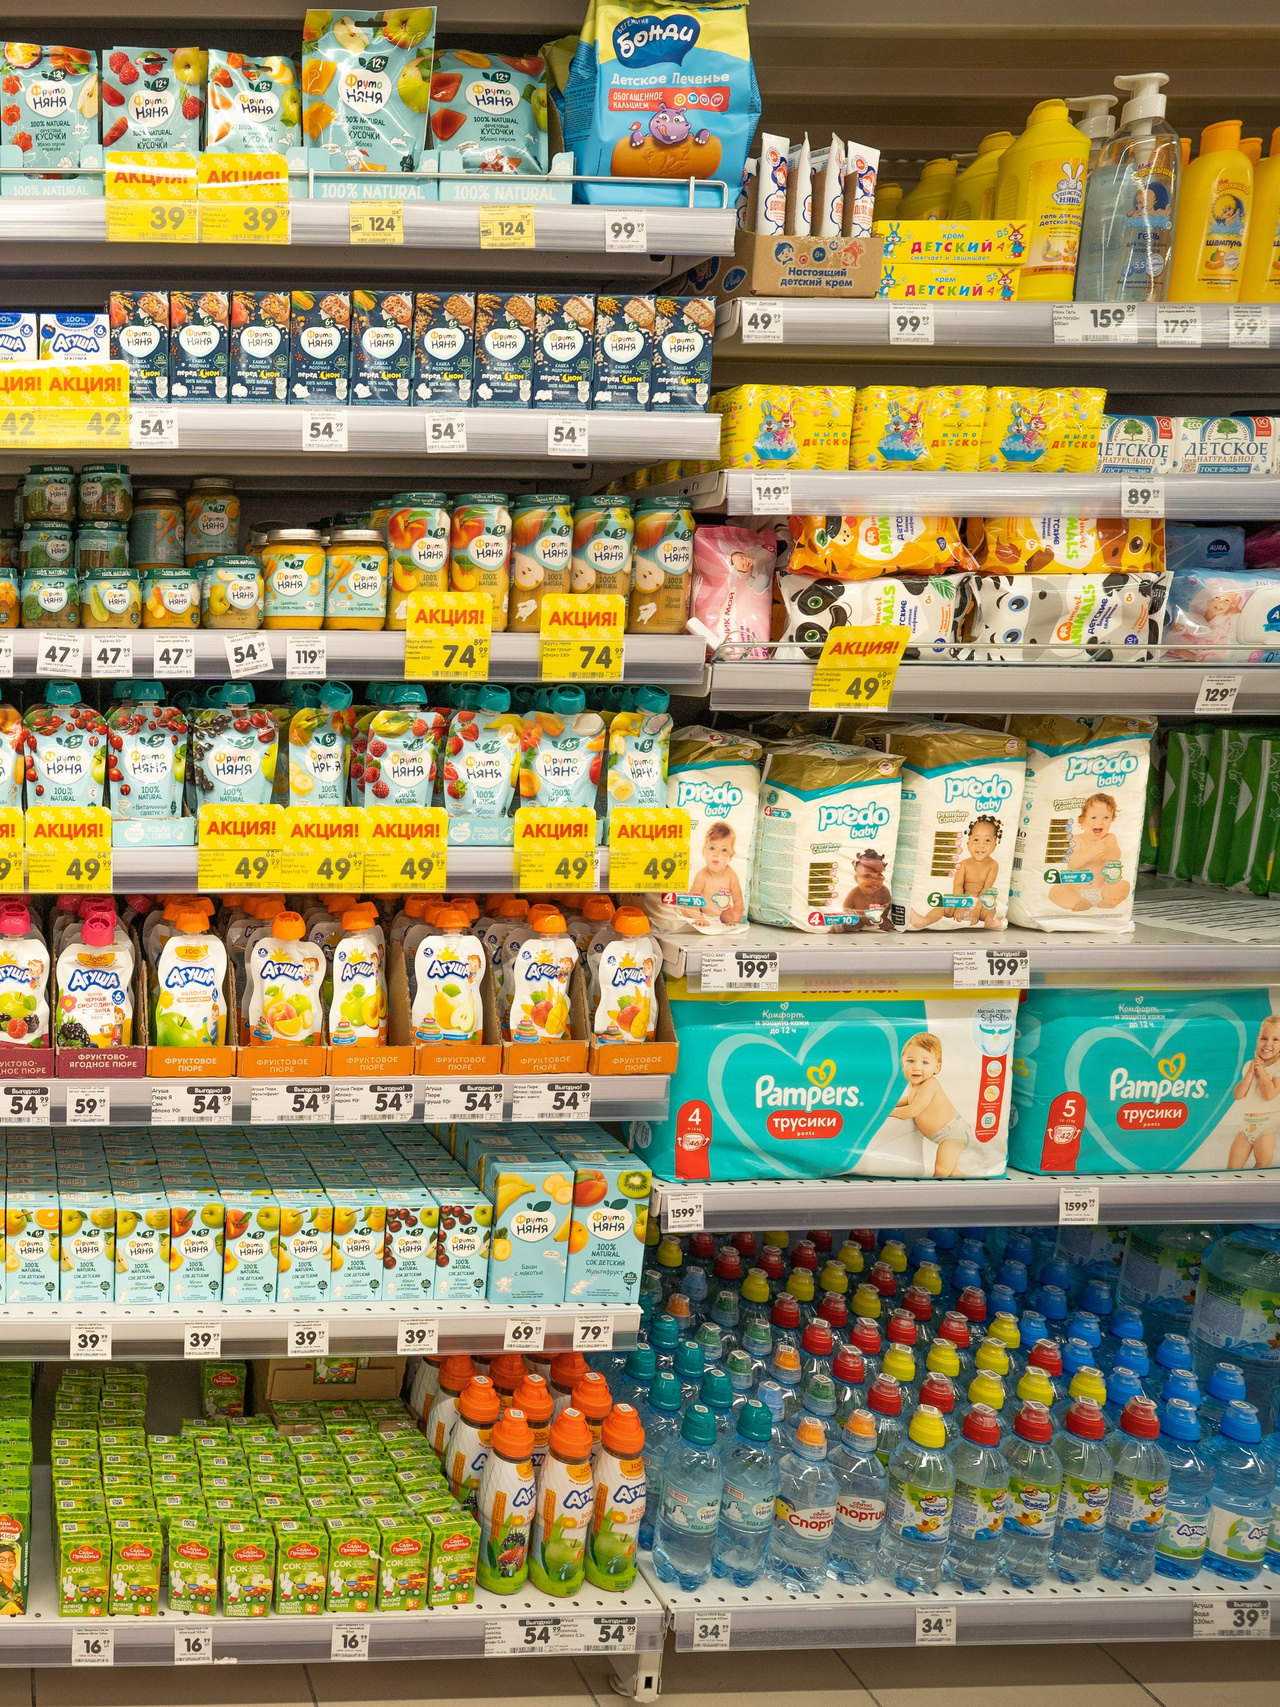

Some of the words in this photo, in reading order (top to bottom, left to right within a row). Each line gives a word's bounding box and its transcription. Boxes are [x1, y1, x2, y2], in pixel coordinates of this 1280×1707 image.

[611, 72, 665, 86] Детское
[672, 71, 730, 85] Печенье
[150, 206, 185, 230] 39
[369, 217, 395, 231] 124
[611, 223, 635, 239] 99
[909, 239, 993, 254] ДЕТСКИЙ
[787, 266, 848, 279] Настоящий
[780, 276, 822, 290] детский
[826, 278, 853, 290] крем
[748, 313, 771, 329] 49
[1090, 309, 1126, 328] 159
[554, 427, 576, 443] 54
[1183, 440, 1268, 458] ДЕТСКОЕ
[756, 486, 781, 501] 149
[1128, 489, 1151, 504] 89
[414, 608, 484, 625] АКЦИЯ!
[234, 644, 257, 663] 54
[443, 645, 476, 668] 74
[828, 638, 900, 659] АКЦИЯ!
[846, 678, 879, 700] 49
[1205, 689, 1229, 701] 129
[944, 774, 1013, 803] predo
[975, 793, 1002, 813] baby
[818, 802, 889, 832] predo
[522, 822, 589, 840] АКЦИЯ!
[617, 822, 684, 841] АКЦИЯ!
[235, 857, 268, 879] 49
[644, 858, 676, 880] 49
[736, 961, 768, 978] 199
[164, 1057, 217, 1066] ФРУКТОВОЕ
[194, 1087, 224, 1095] Выгодно!
[756, 1075, 860, 1111] Pampers
[1110, 1067, 1207, 1103] Pampers
[193, 1096, 221, 1114] 54
[464, 1093, 493, 1111] 54
[1063, 1100, 1077, 1116] 5
[688, 1108, 701, 1126] 4
[773, 1115, 837, 1130] трусики
[1065, 1202, 1088, 1211] 1599
[516, 1224, 550, 1236] НЯНЯ
[596, 1243, 617, 1251] 100%
[78, 1334, 99, 1348] 39
[512, 1326, 533, 1340] 69
[1233, 1609, 1259, 1627] 39
[699, 1625, 720, 1639] 34
[84, 1640, 101, 1654] 16
